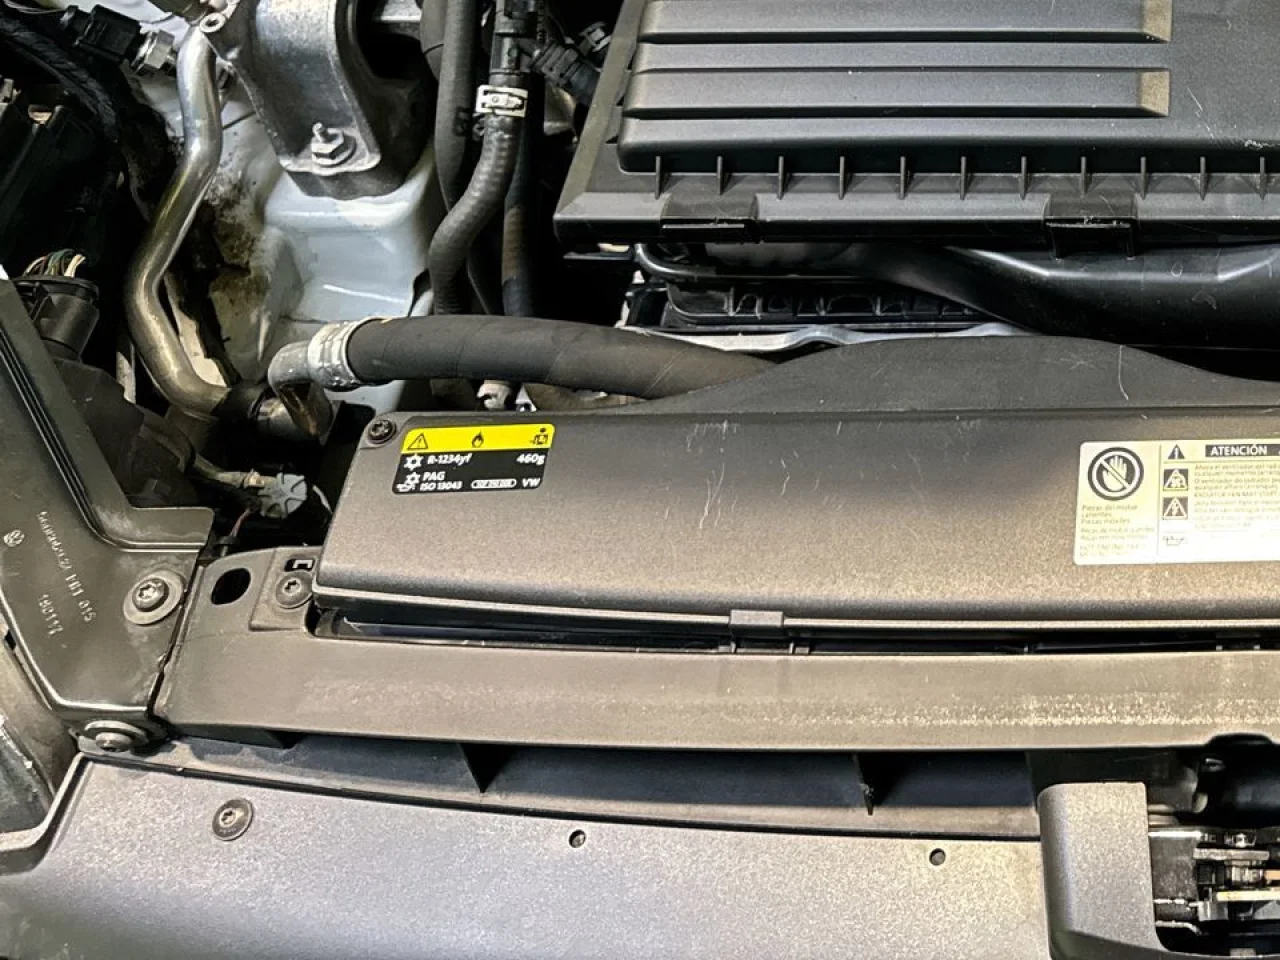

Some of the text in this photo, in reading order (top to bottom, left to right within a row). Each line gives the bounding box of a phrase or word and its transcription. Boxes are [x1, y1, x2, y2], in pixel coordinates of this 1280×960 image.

[1210, 444, 1267, 456] ATENCIÓN
[427, 453, 546, 466] R-1234yf 460g
[423, 472, 446, 481] PAG
[420, 482, 436, 491] ISO
[437, 481, 463, 490] 13043
[522, 478, 541, 487] VW
